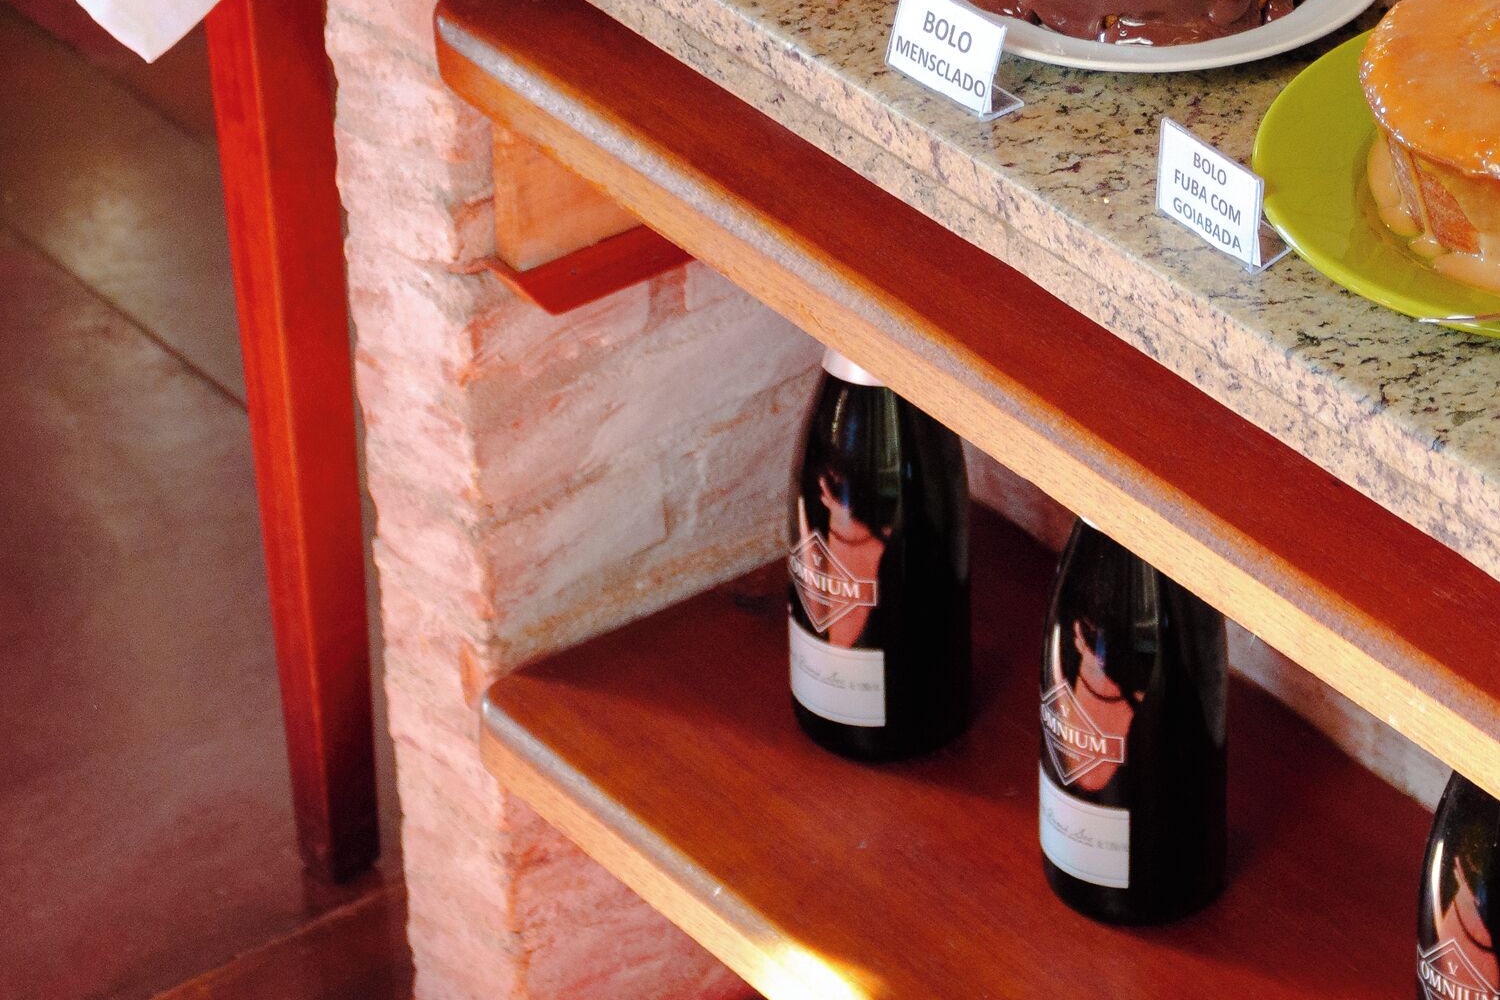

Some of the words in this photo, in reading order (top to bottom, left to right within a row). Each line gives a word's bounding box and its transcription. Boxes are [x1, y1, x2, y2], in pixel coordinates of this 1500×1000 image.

[923, 10, 972, 53] BOLO
[895, 35, 986, 98] MENSCLADO
[1193, 151, 1227, 186] BOLO
[1174, 168, 1207, 204] FUBA
[1211, 194, 1241, 226] COM
[1173, 197, 1242, 253] GOIABADA
[1041, 703, 1107, 754] OMNIUM
